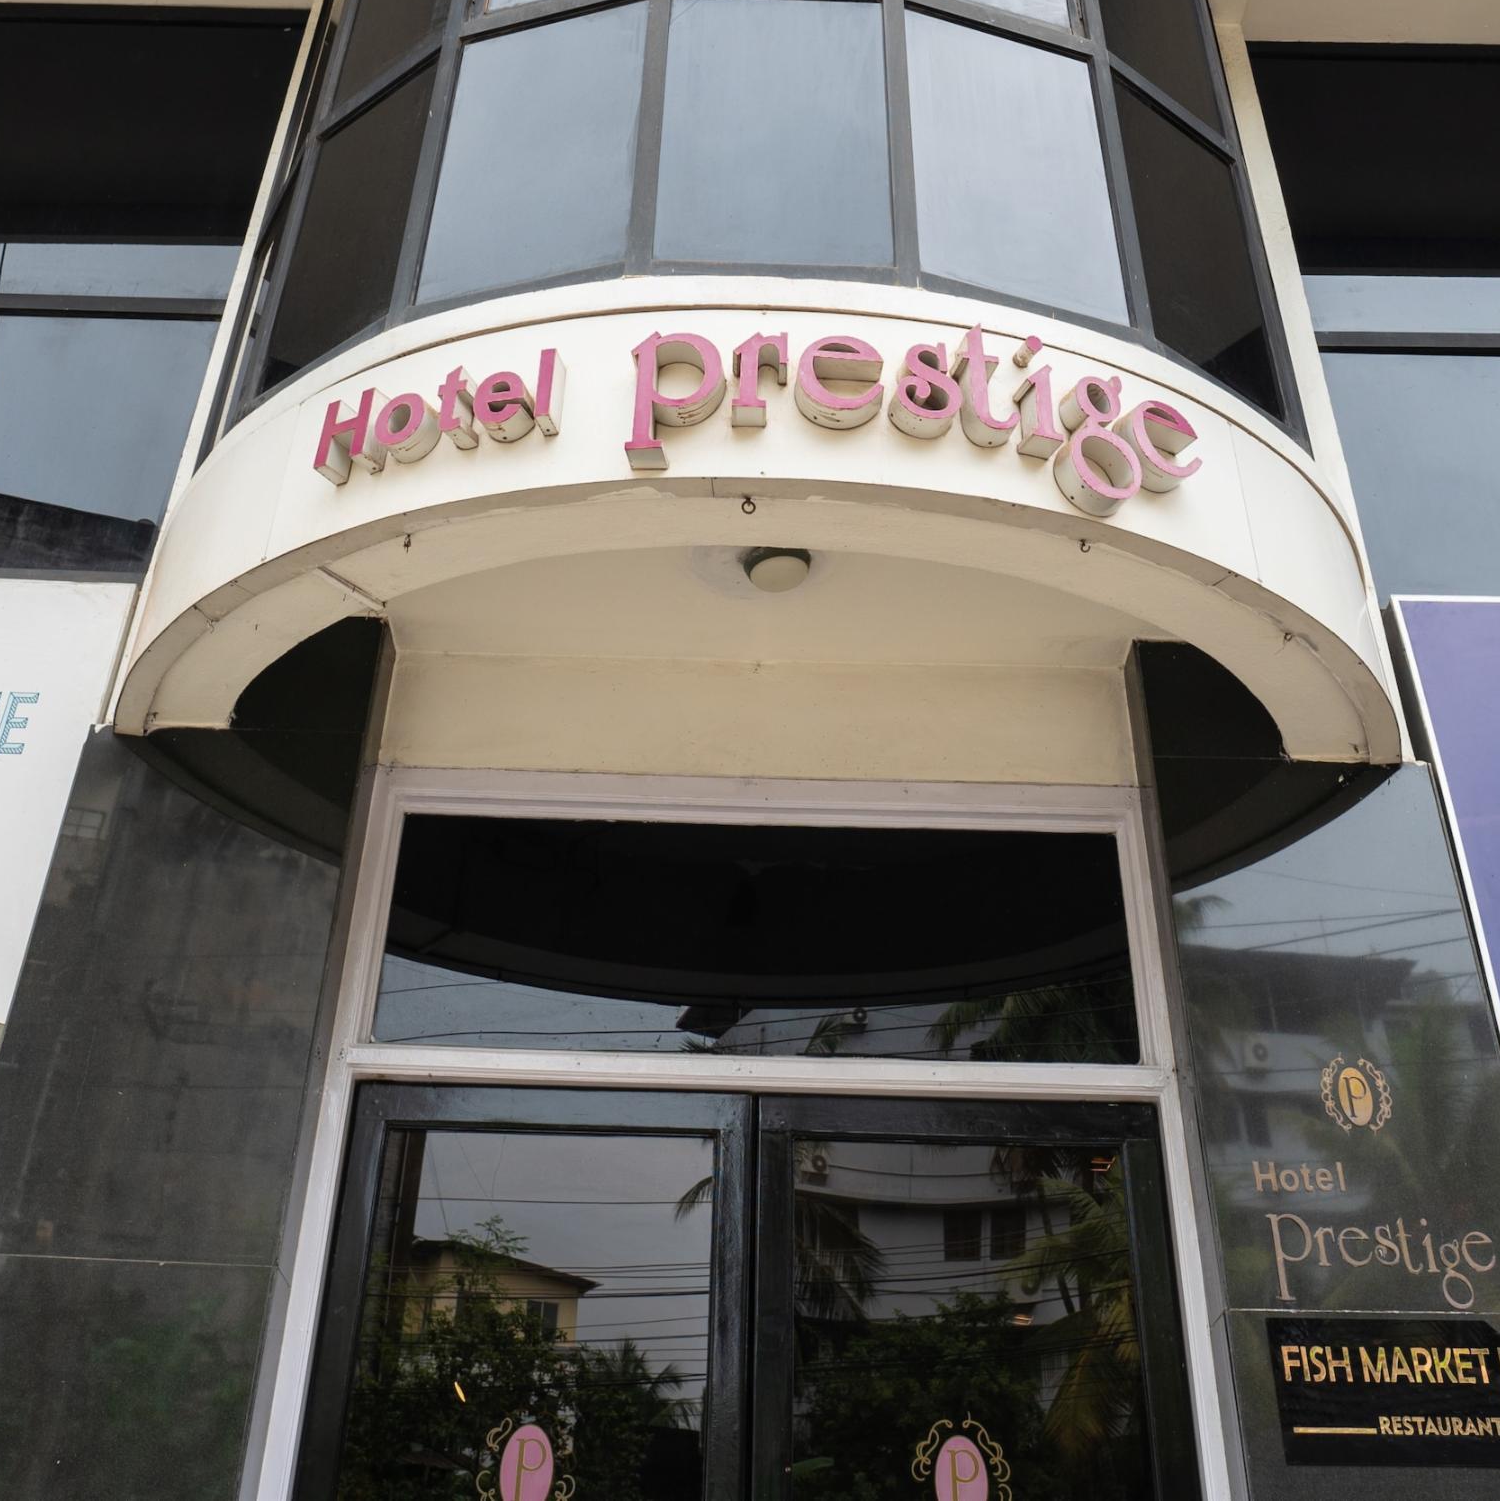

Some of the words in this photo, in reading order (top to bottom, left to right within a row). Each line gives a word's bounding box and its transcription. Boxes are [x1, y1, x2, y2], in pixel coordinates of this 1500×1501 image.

[313, 348, 567, 486] Hotel
[1252, 1160, 1346, 1194] Hotel
[1280, 1345, 1354, 1383] FISH
[1359, 1347, 1490, 1384] MARKET
